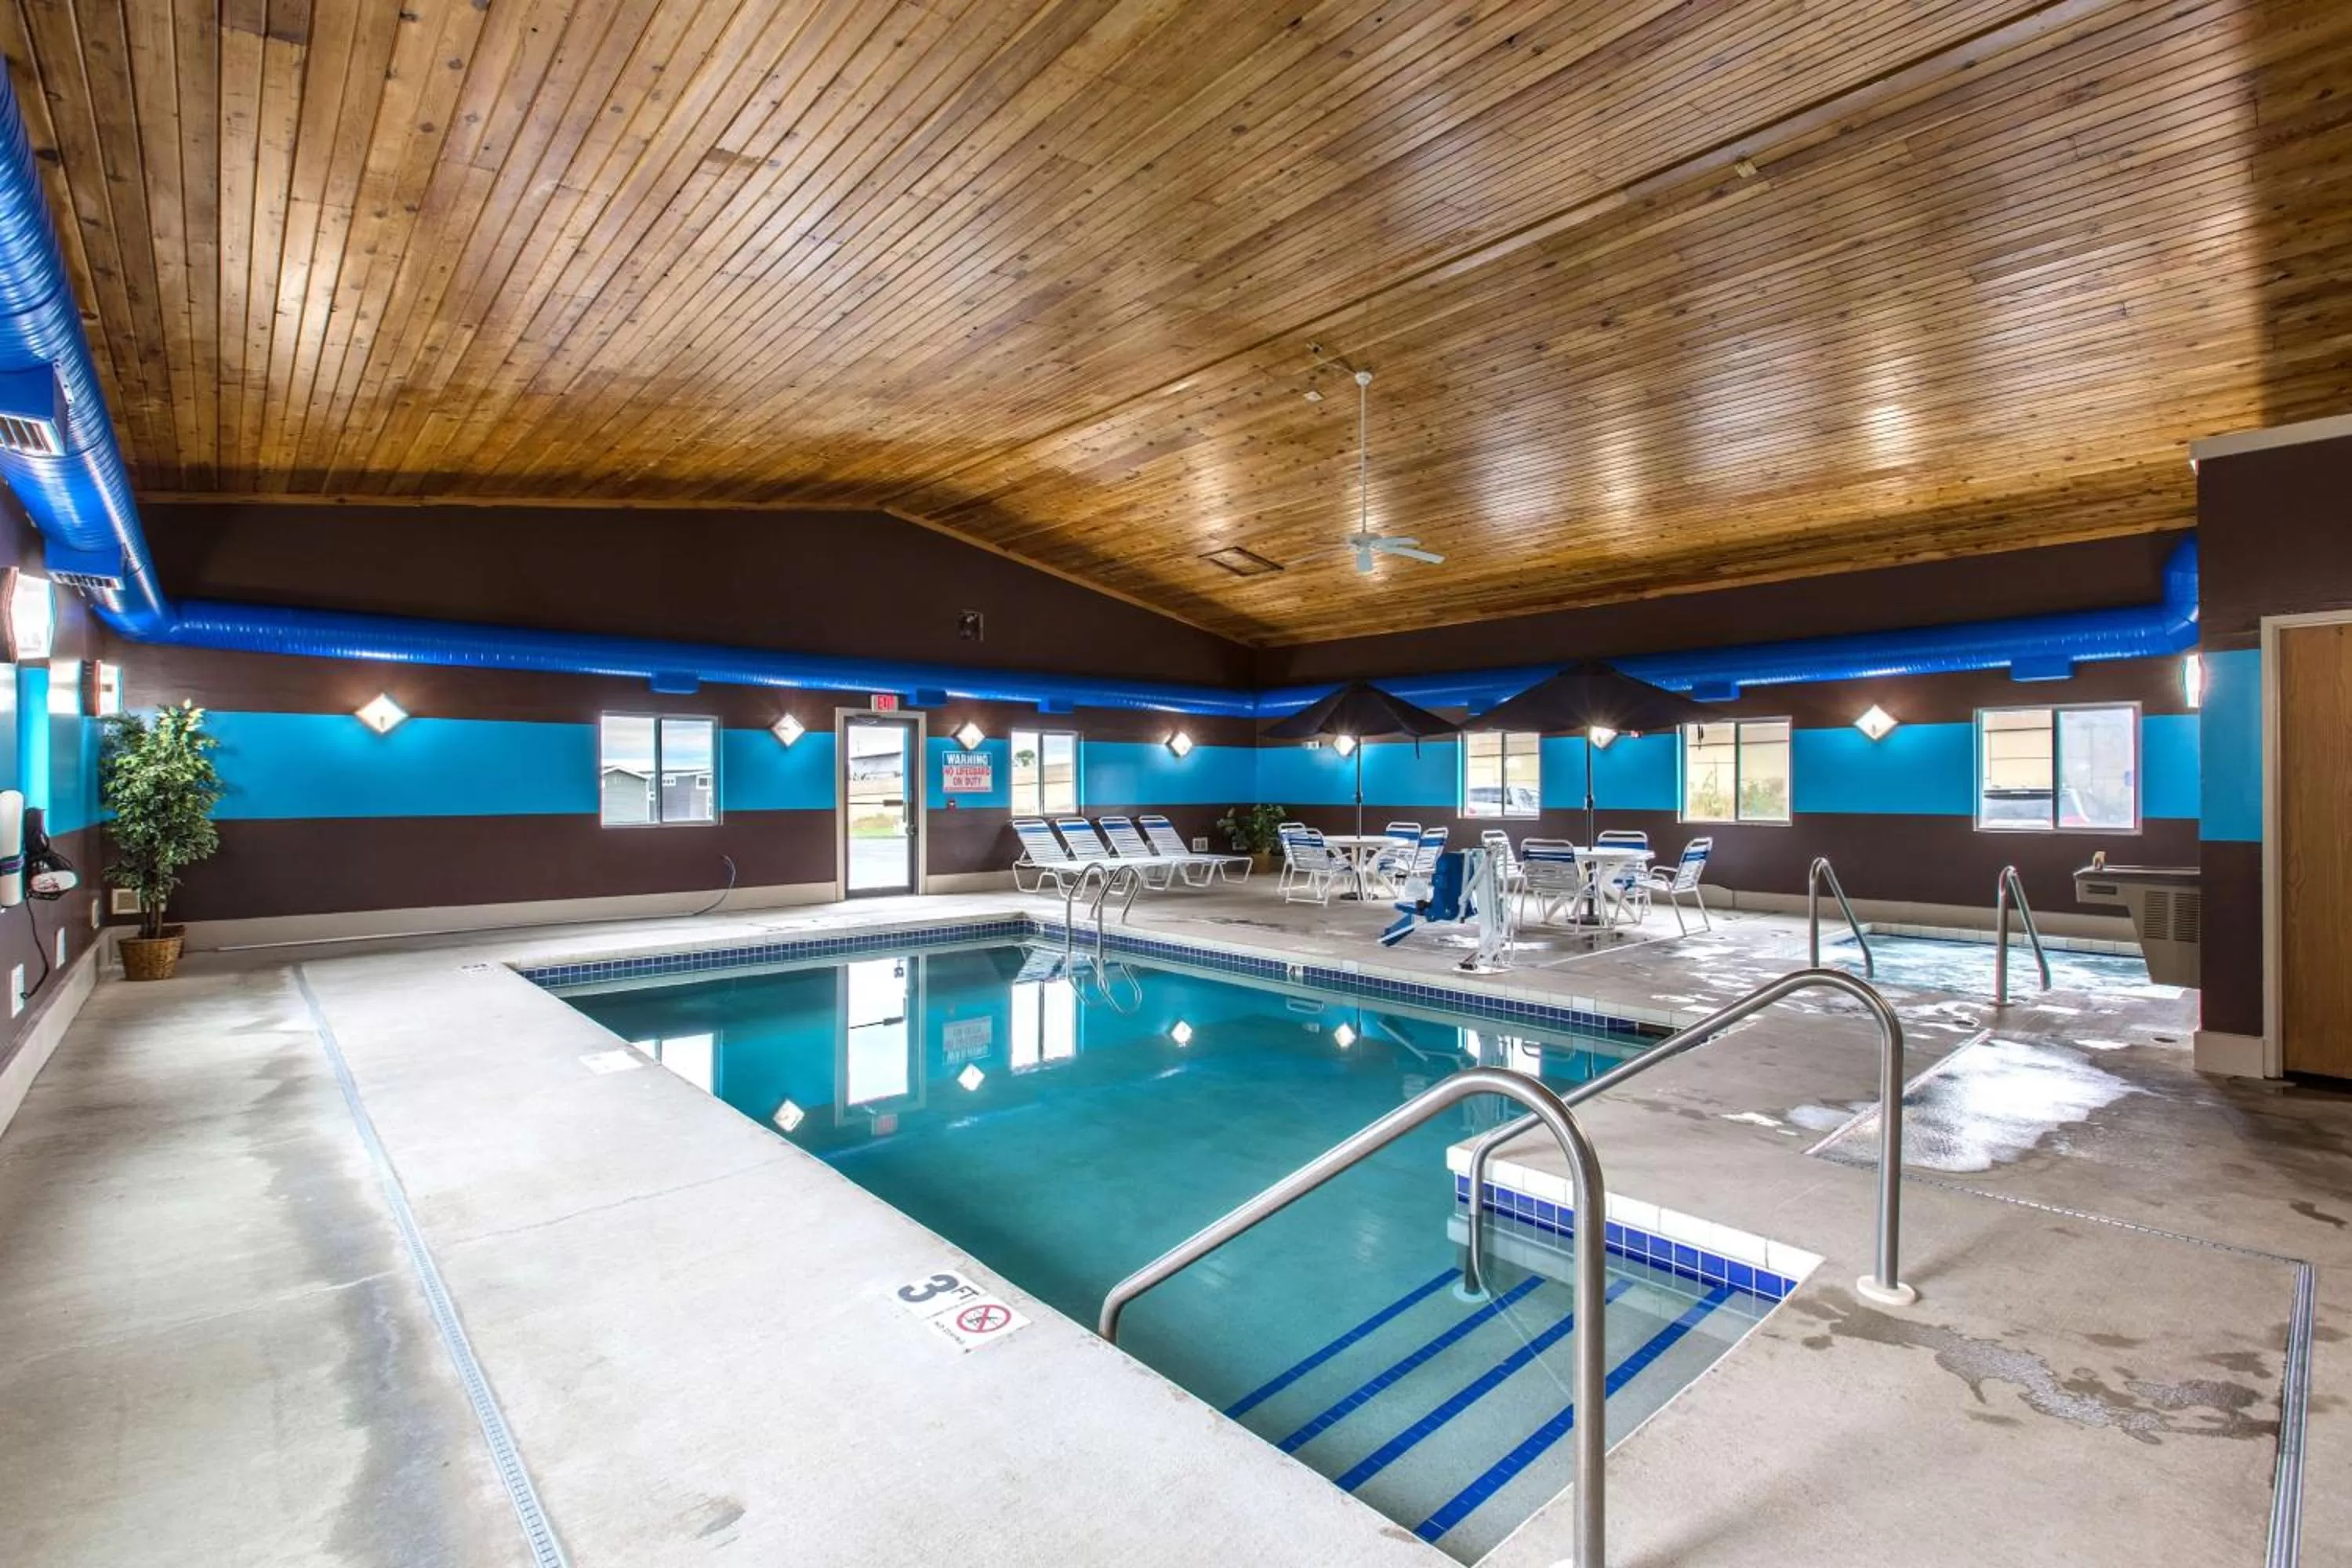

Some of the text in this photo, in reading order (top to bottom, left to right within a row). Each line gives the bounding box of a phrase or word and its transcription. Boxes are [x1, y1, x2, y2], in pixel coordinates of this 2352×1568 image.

[946, 753, 988, 766] WARNING
[944, 767, 990, 776] NO LIFEGUARD
[953, 777, 982, 786] ON DUTY
[897, 1274, 979, 1303] 3 FT
